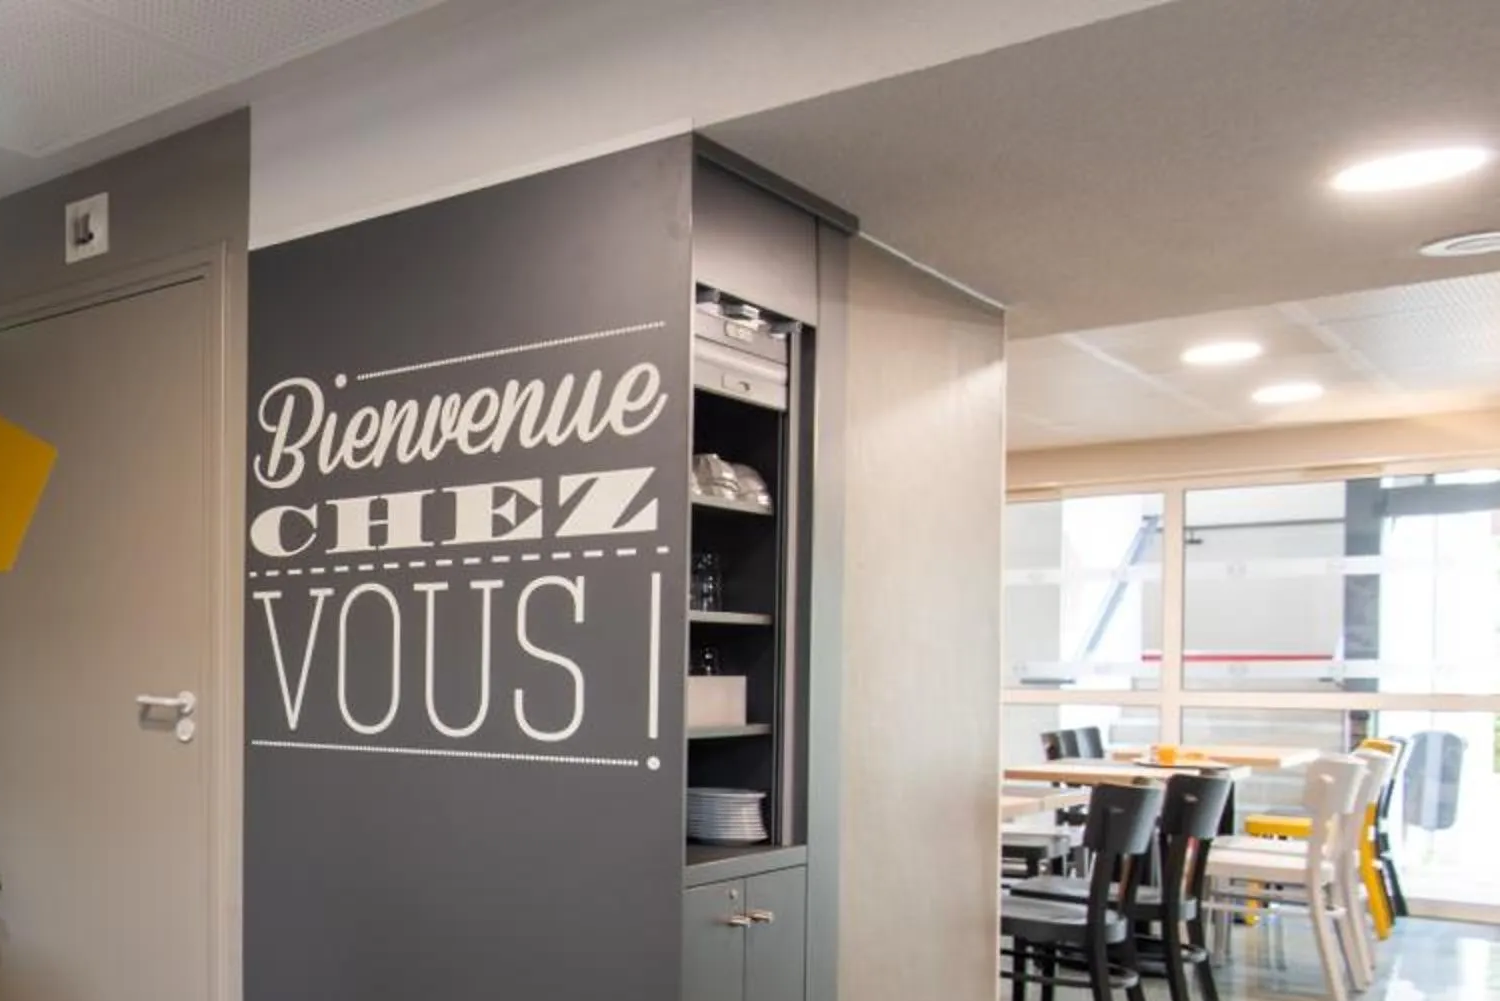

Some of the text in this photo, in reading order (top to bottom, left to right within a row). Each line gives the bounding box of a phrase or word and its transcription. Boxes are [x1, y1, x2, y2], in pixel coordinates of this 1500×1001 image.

[253, 362, 668, 489] Bienvenue
[250, 467, 658, 557] CHEZ
[253, 575, 585, 742] VOUS
